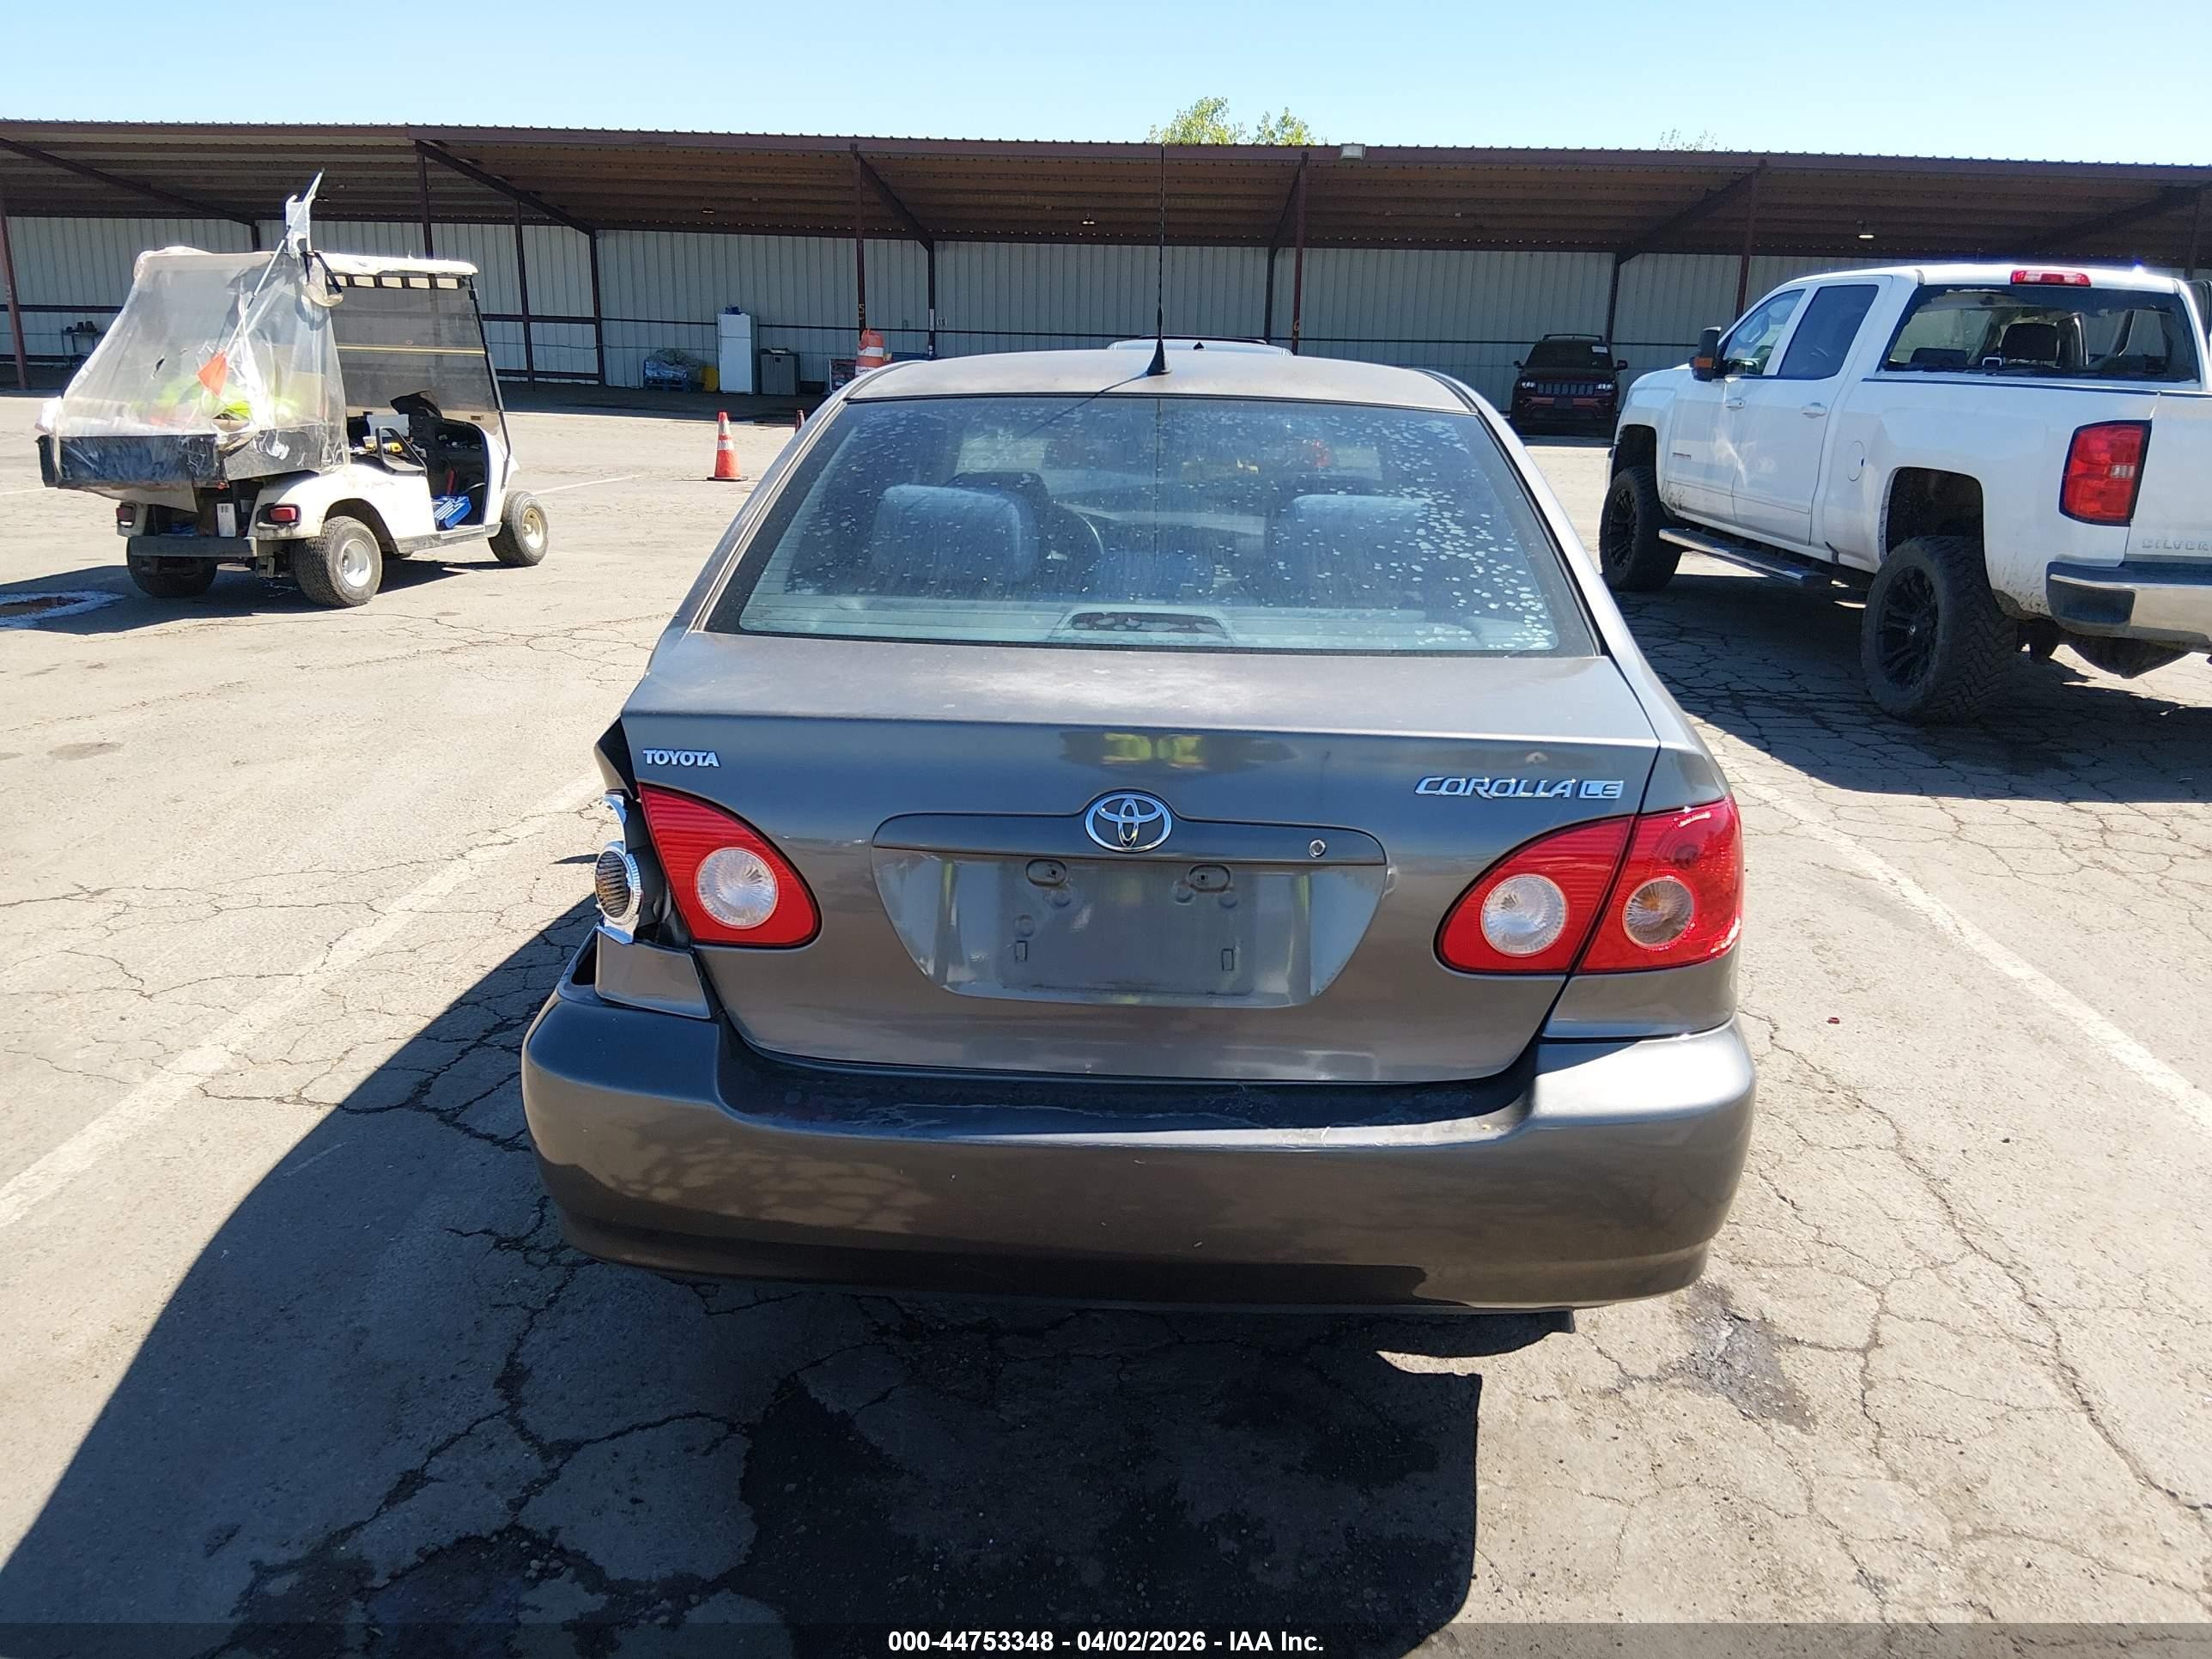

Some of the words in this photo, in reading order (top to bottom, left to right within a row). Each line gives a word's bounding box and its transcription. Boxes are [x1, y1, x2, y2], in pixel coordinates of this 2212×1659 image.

[642, 749, 720, 767] TOYOTA
[1415, 776, 1577, 799] COROLLA
[1578, 780, 1624, 799] LE
